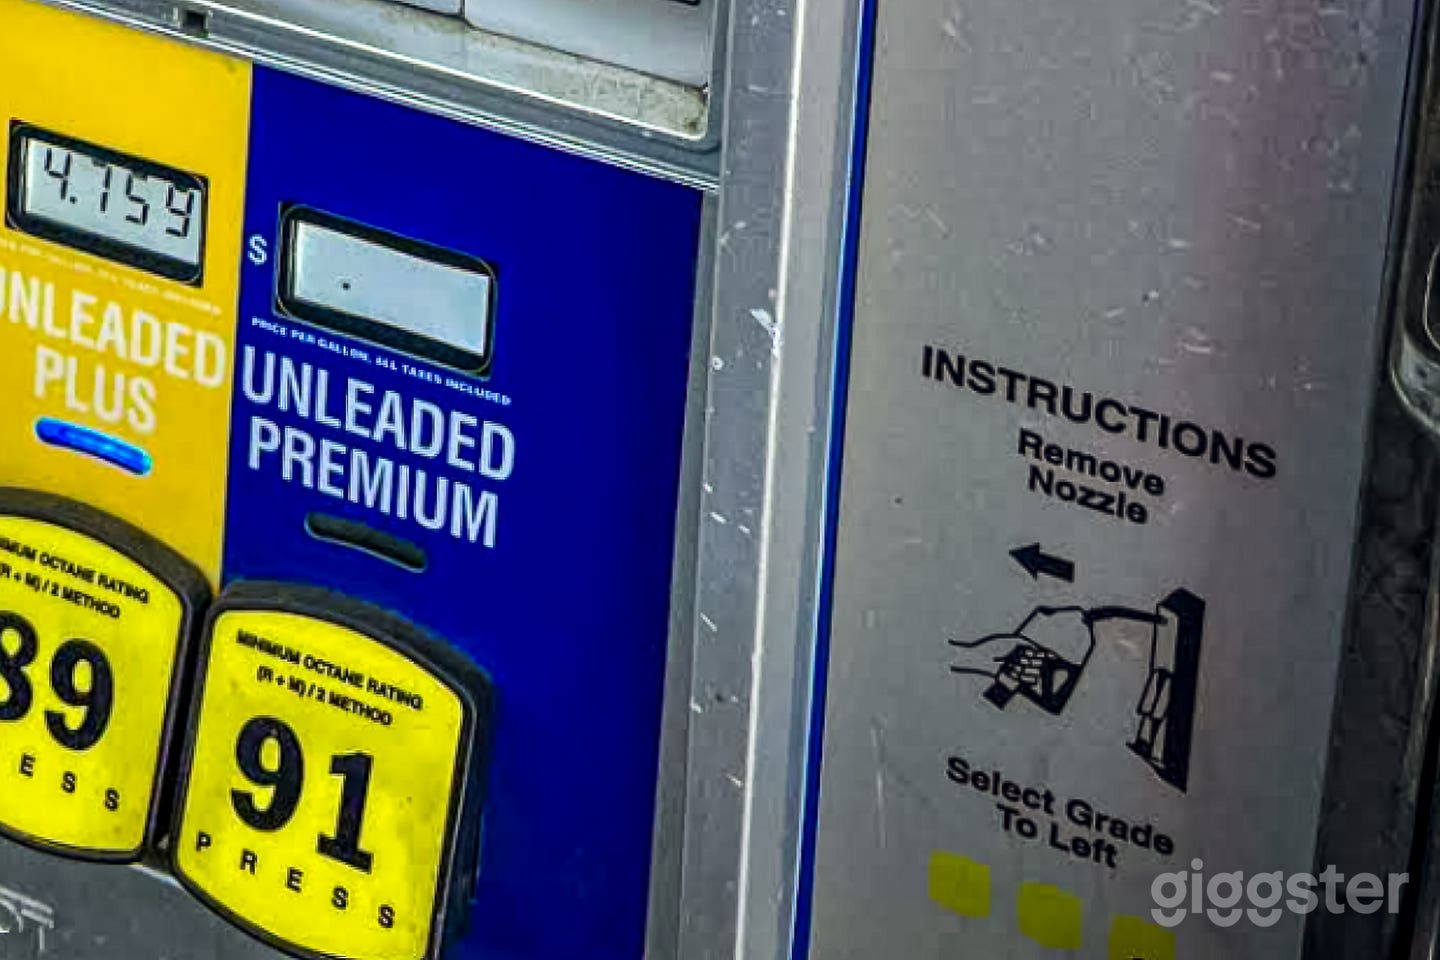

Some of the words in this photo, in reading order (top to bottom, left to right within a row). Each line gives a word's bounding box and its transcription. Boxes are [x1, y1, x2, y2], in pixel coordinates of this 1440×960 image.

[44, 147, 195, 239] 4.159
[247, 233, 267, 266] $
[34, 343, 158, 433] PLUS
[242, 344, 516, 481] UNLEADED
[921, 345, 1278, 480] INSTRUCTIONS
[248, 415, 499, 549] PREMIUM
[1017, 427, 1166, 497] Remove
[1027, 464, 1148, 525] Nozzle
[230, 714, 375, 875] 91
[945, 756, 1055, 815] Select
[1066, 799, 1176, 857] Grade
[996, 803, 1038, 841] To
[1049, 823, 1120, 870] Left
